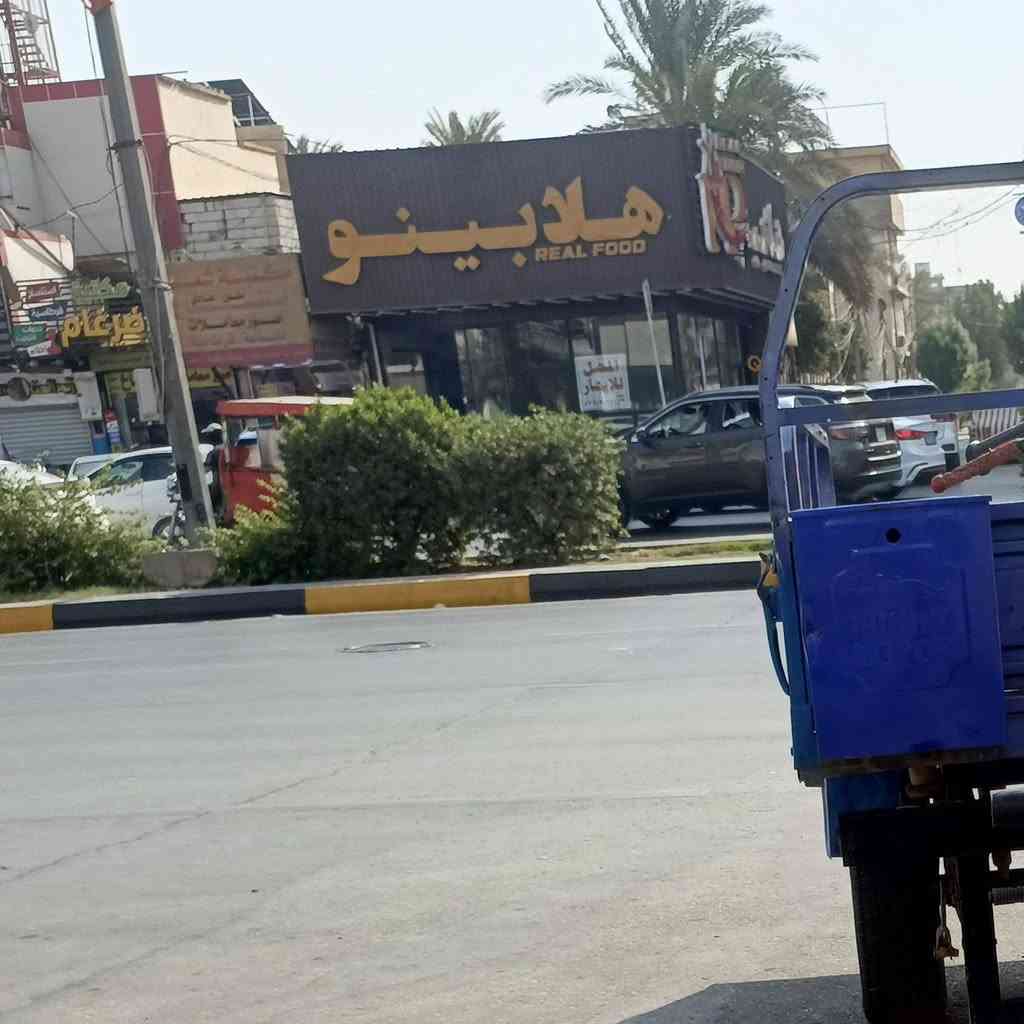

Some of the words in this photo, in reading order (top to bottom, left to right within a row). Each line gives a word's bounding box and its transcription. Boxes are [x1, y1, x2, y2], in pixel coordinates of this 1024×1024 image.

[322, 176, 664, 286] هلابينو
[535, 244, 587, 262] REAL
[591, 239, 646, 257] FOOD
